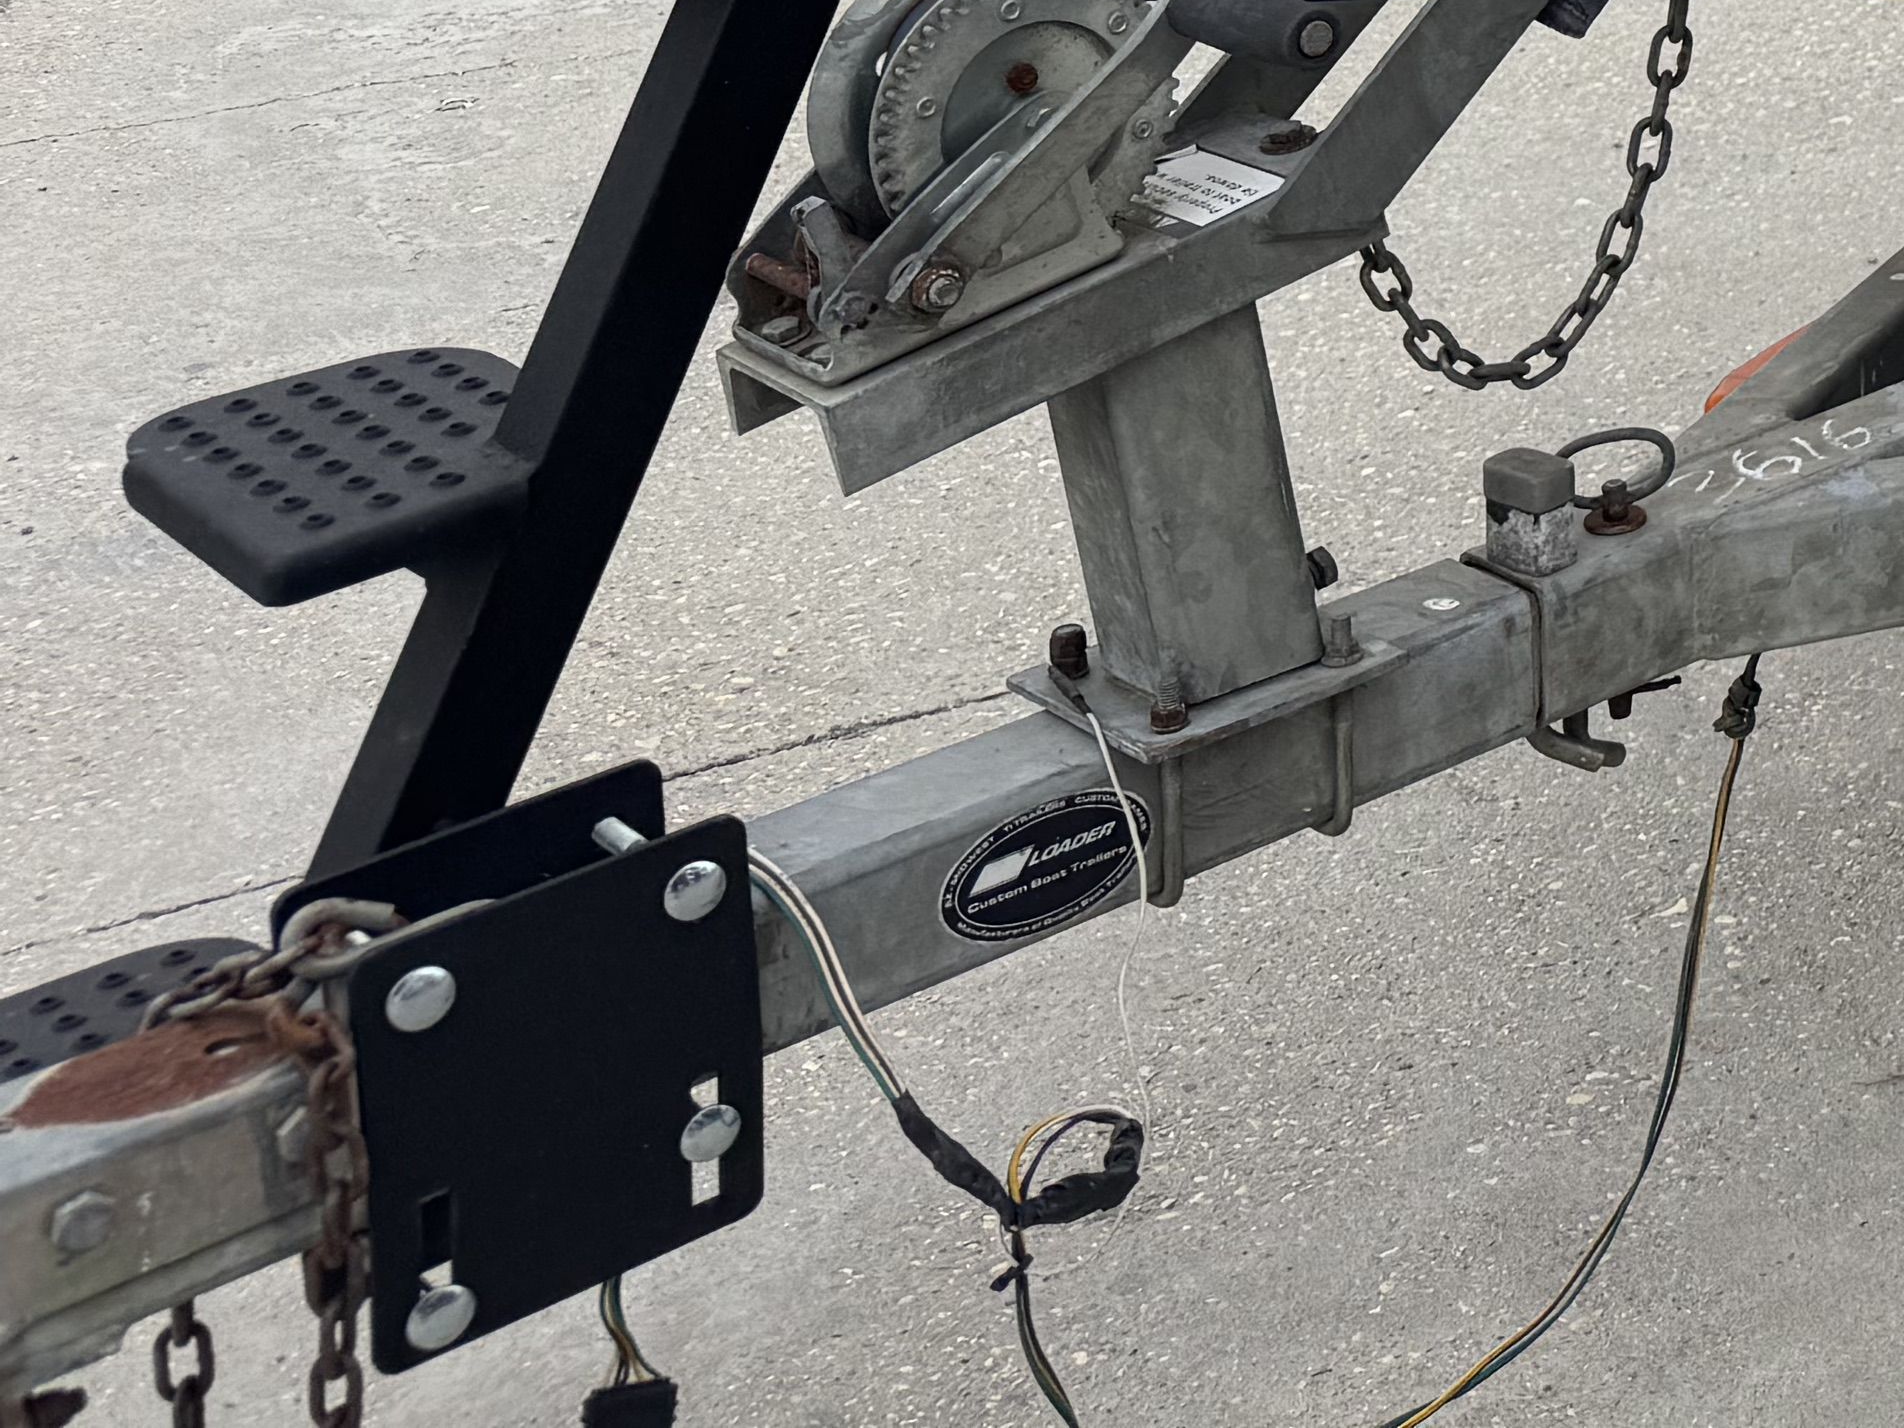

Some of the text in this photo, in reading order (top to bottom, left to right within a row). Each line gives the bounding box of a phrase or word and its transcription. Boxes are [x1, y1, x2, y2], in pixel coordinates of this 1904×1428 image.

[1028, 820, 1117, 867] LOADER
[967, 845, 1128, 914] Custom Boat Trailers
